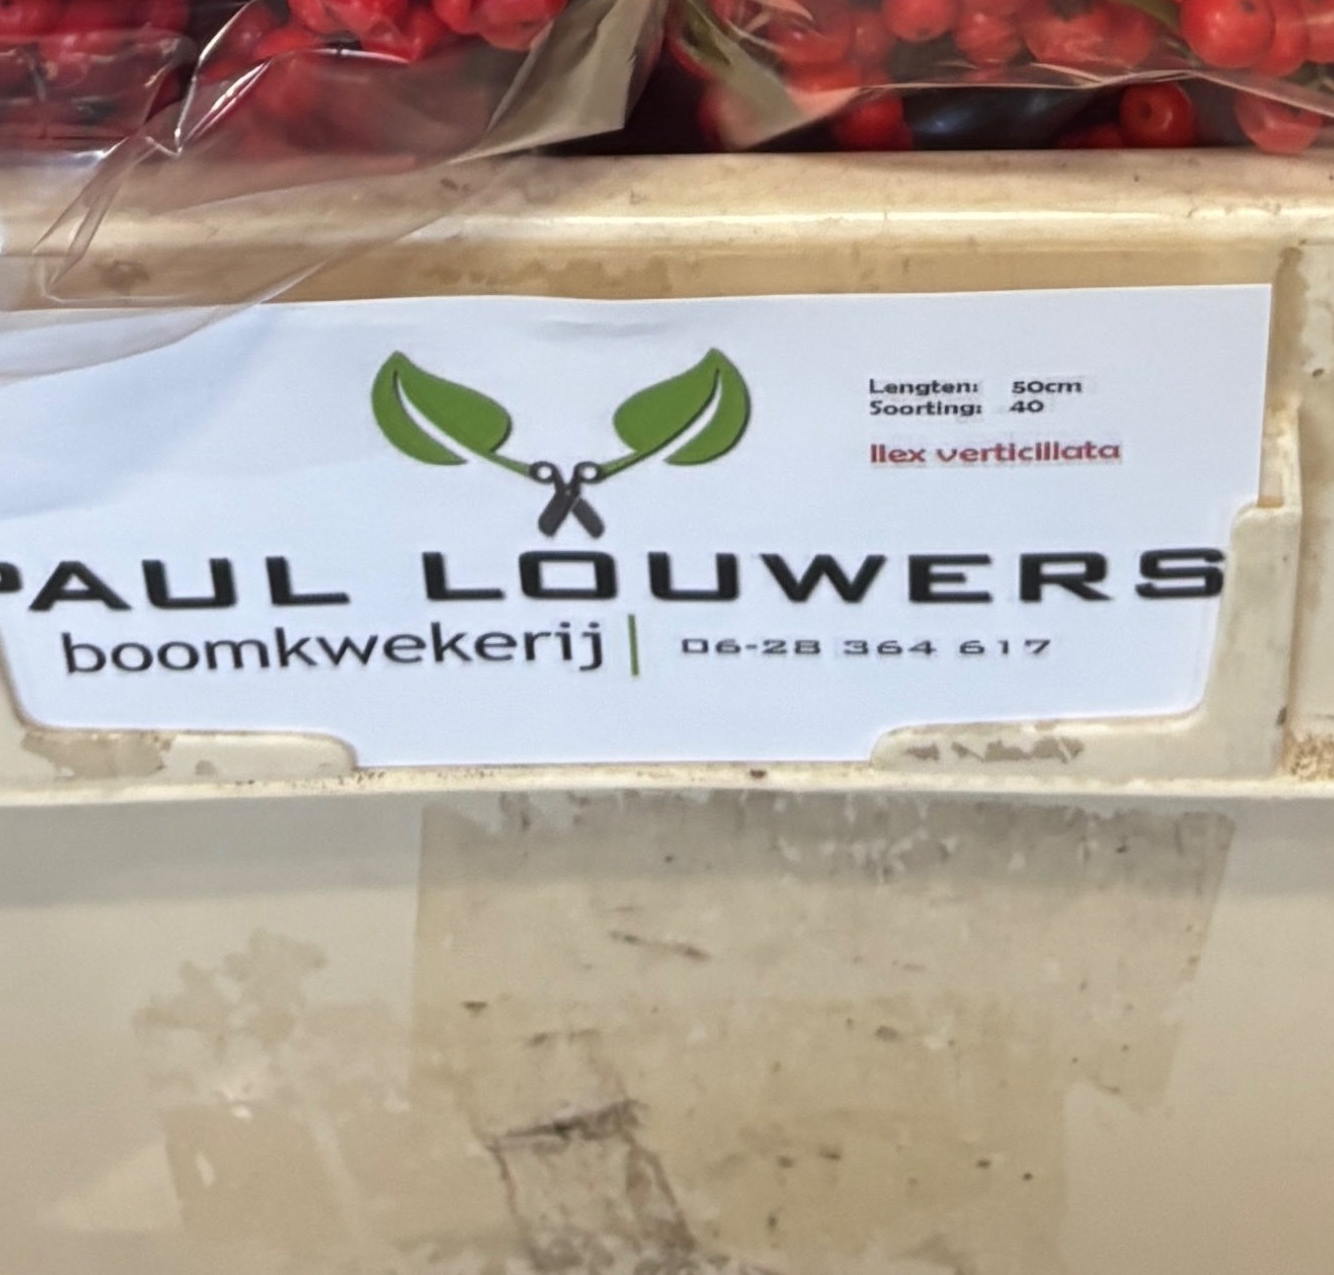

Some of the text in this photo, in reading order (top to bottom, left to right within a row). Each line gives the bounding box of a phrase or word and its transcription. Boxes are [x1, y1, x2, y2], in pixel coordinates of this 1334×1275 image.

[1011, 380, 1083, 395] 50cm
[869, 400, 1044, 417] Soorting: 40
[870, 440, 1121, 464] Ilex verticillata
[422, 548, 1225, 603] LOUWERS
[63, 621, 1051, 675] boomkwekerij 06-28 364 617
